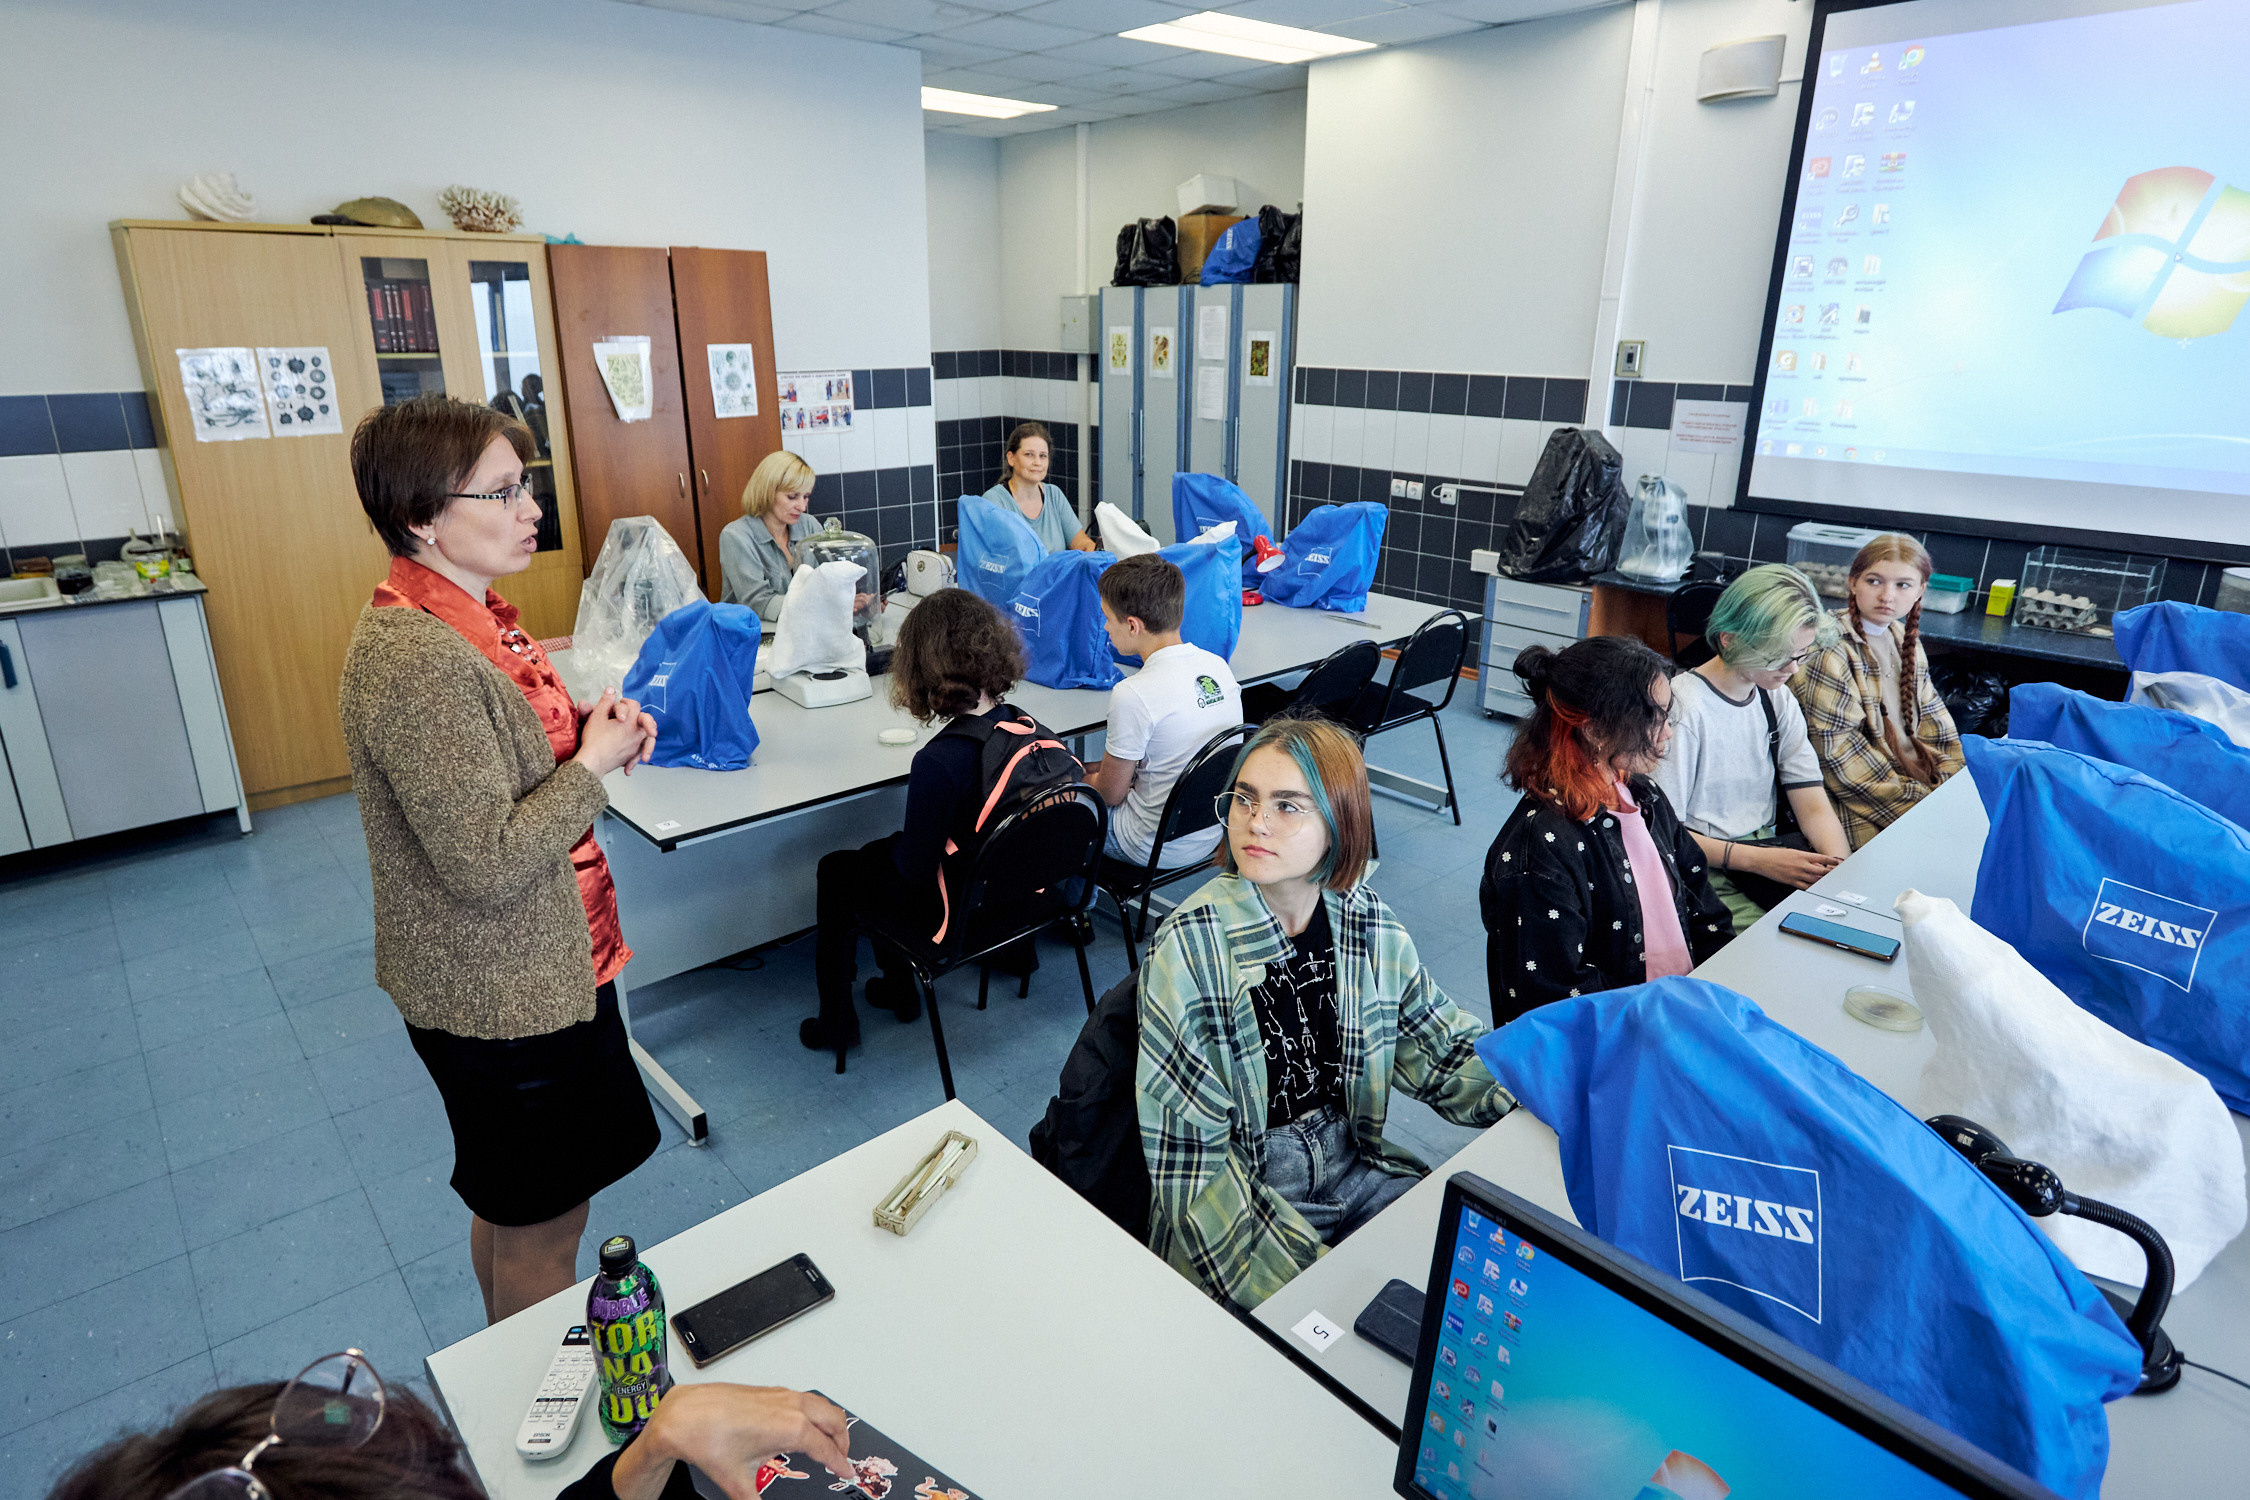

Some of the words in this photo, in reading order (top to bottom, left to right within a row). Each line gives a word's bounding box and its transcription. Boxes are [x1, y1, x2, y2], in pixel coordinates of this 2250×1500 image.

[980, 560, 1006, 573] ZEISS
[2095, 902, 2202, 948] ZEISS
[1678, 1184, 1814, 1244] ZEISS
[592, 1287, 650, 1321] BUBBLE
[591, 1310, 657, 1354] TOR
[1313, 1325, 1329, 1339] 5
[602, 1350, 654, 1384] NA
[617, 1382, 647, 1395] ENERGY
